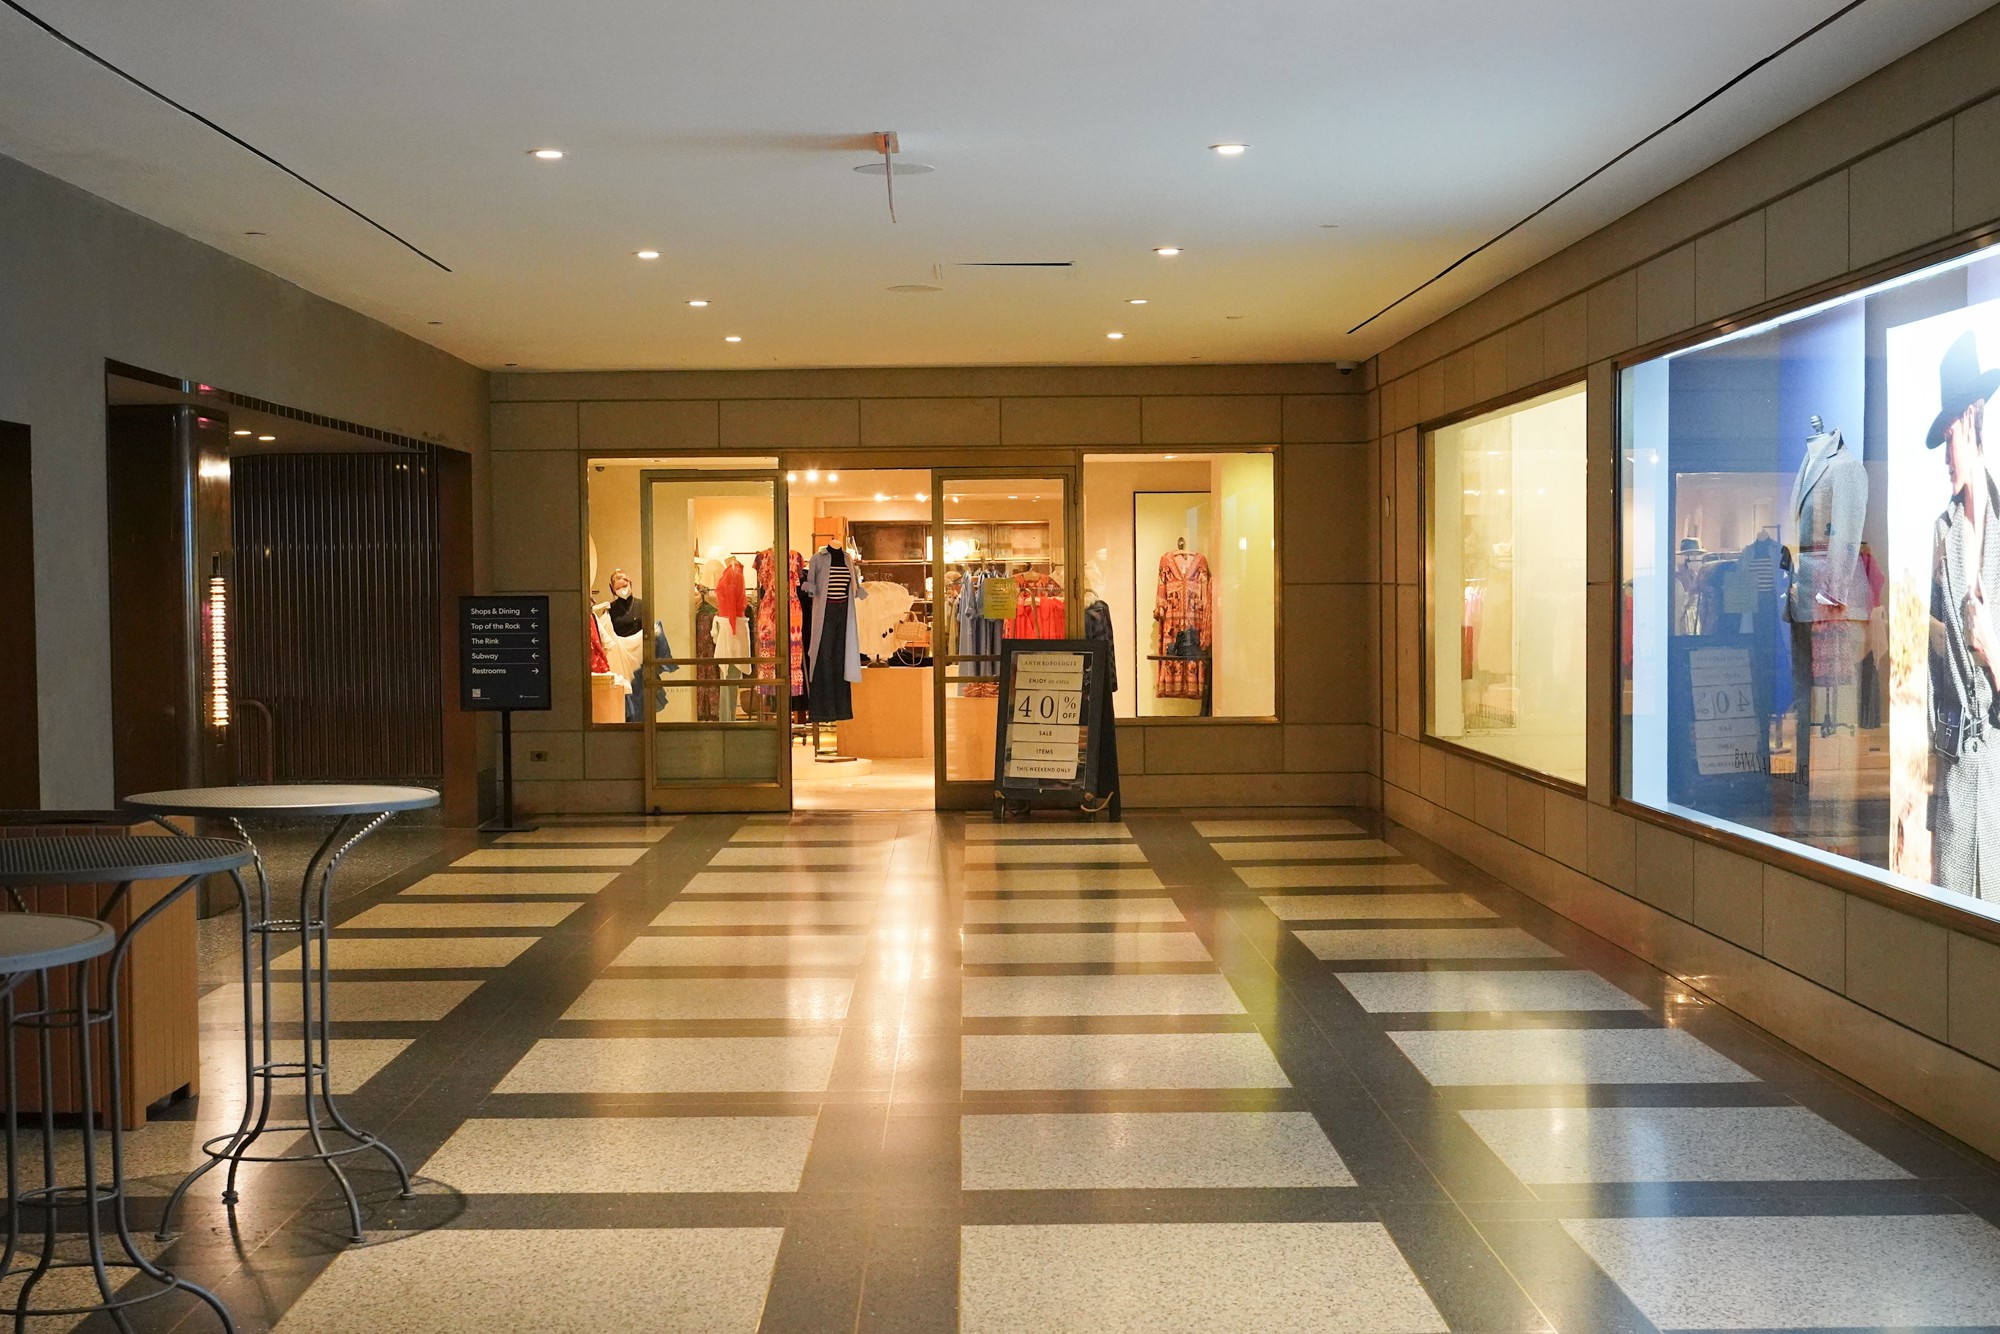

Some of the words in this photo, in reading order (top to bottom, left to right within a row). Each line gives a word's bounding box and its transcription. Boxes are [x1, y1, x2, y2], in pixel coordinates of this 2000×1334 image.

[470, 607, 491, 616] Shops
[492, 607, 498, 615] &
[498, 607, 521, 616] Dining
[471, 622, 484, 631] Top
[484, 622, 492, 630] of
[492, 622, 504, 630] the
[504, 622, 521, 630] Rock
[471, 637, 484, 645] The
[484, 637, 500, 645] Rink
[471, 652, 499, 661] Subway
[472, 667, 507, 675] Restrooms
[1735, 748, 1768, 777] BANANA
